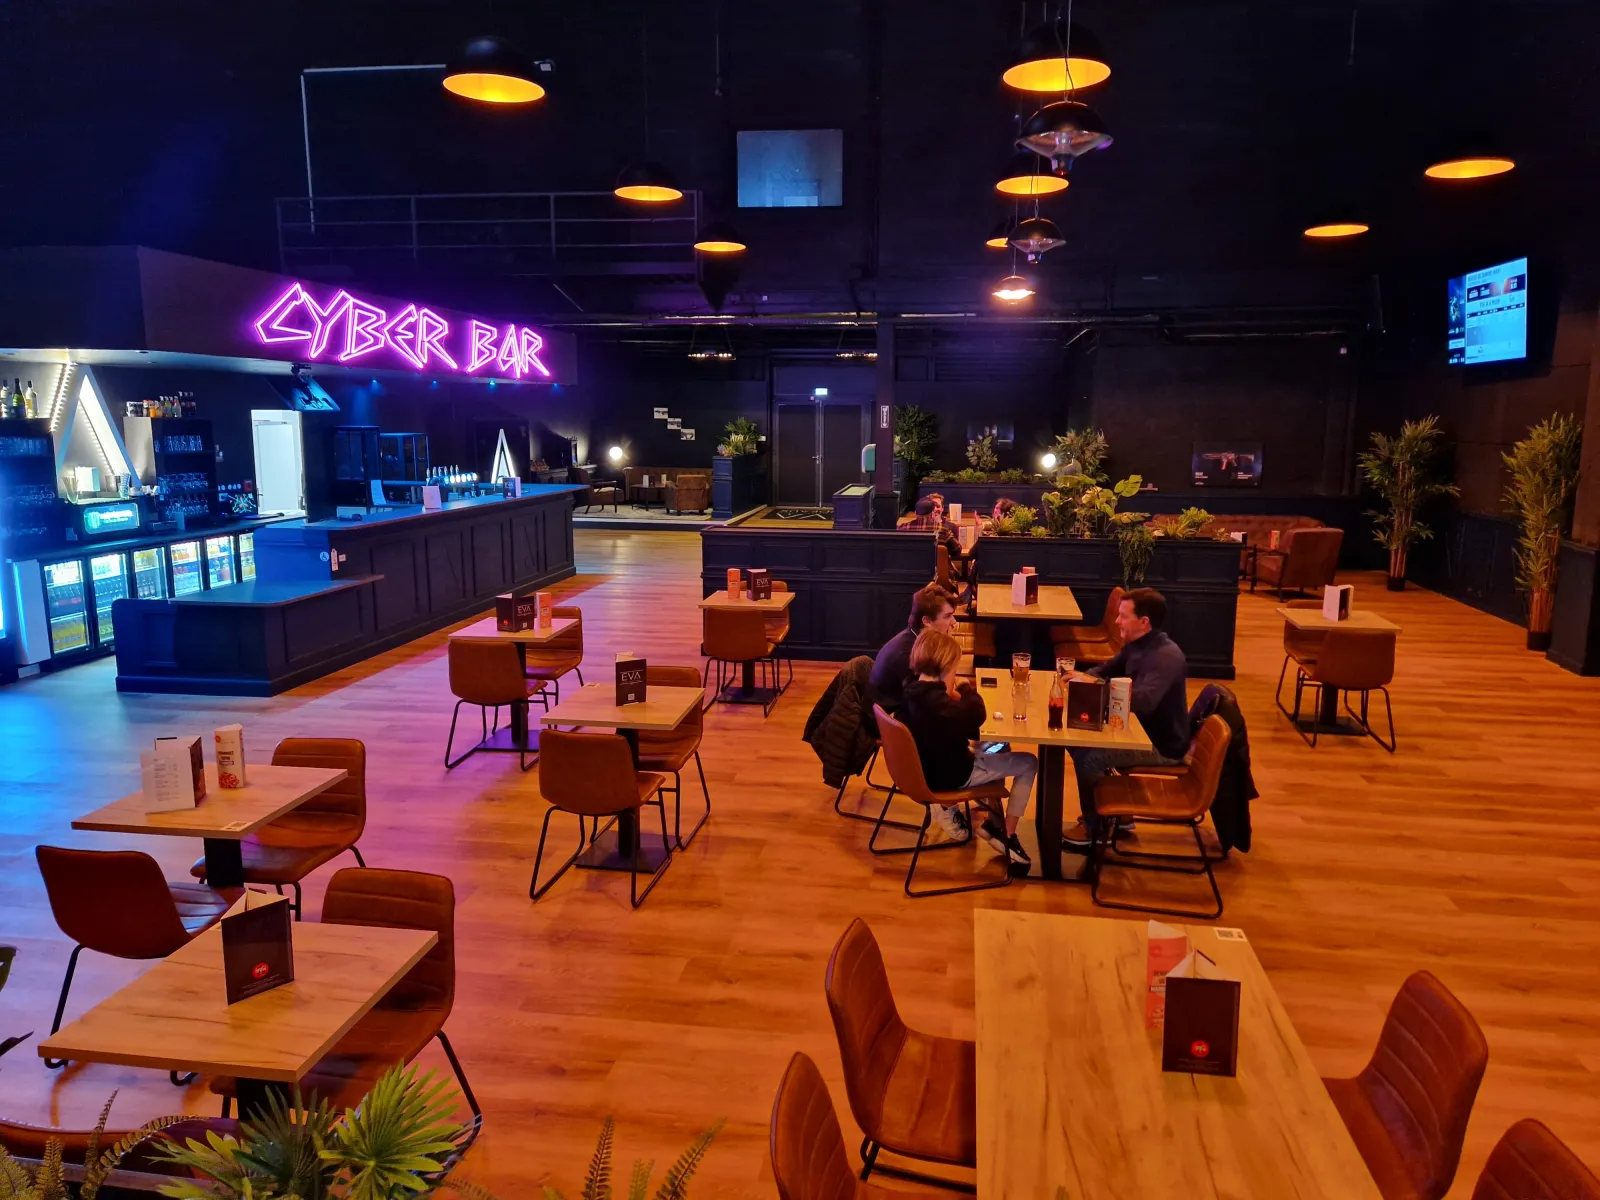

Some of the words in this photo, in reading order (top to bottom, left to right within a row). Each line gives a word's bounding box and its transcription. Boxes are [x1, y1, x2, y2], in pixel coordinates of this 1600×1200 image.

[253, 280, 458, 369] CYBER
[466, 318, 551, 379] BAR
[517, 605, 532, 613] EVA
[621, 671, 641, 682] EVA
